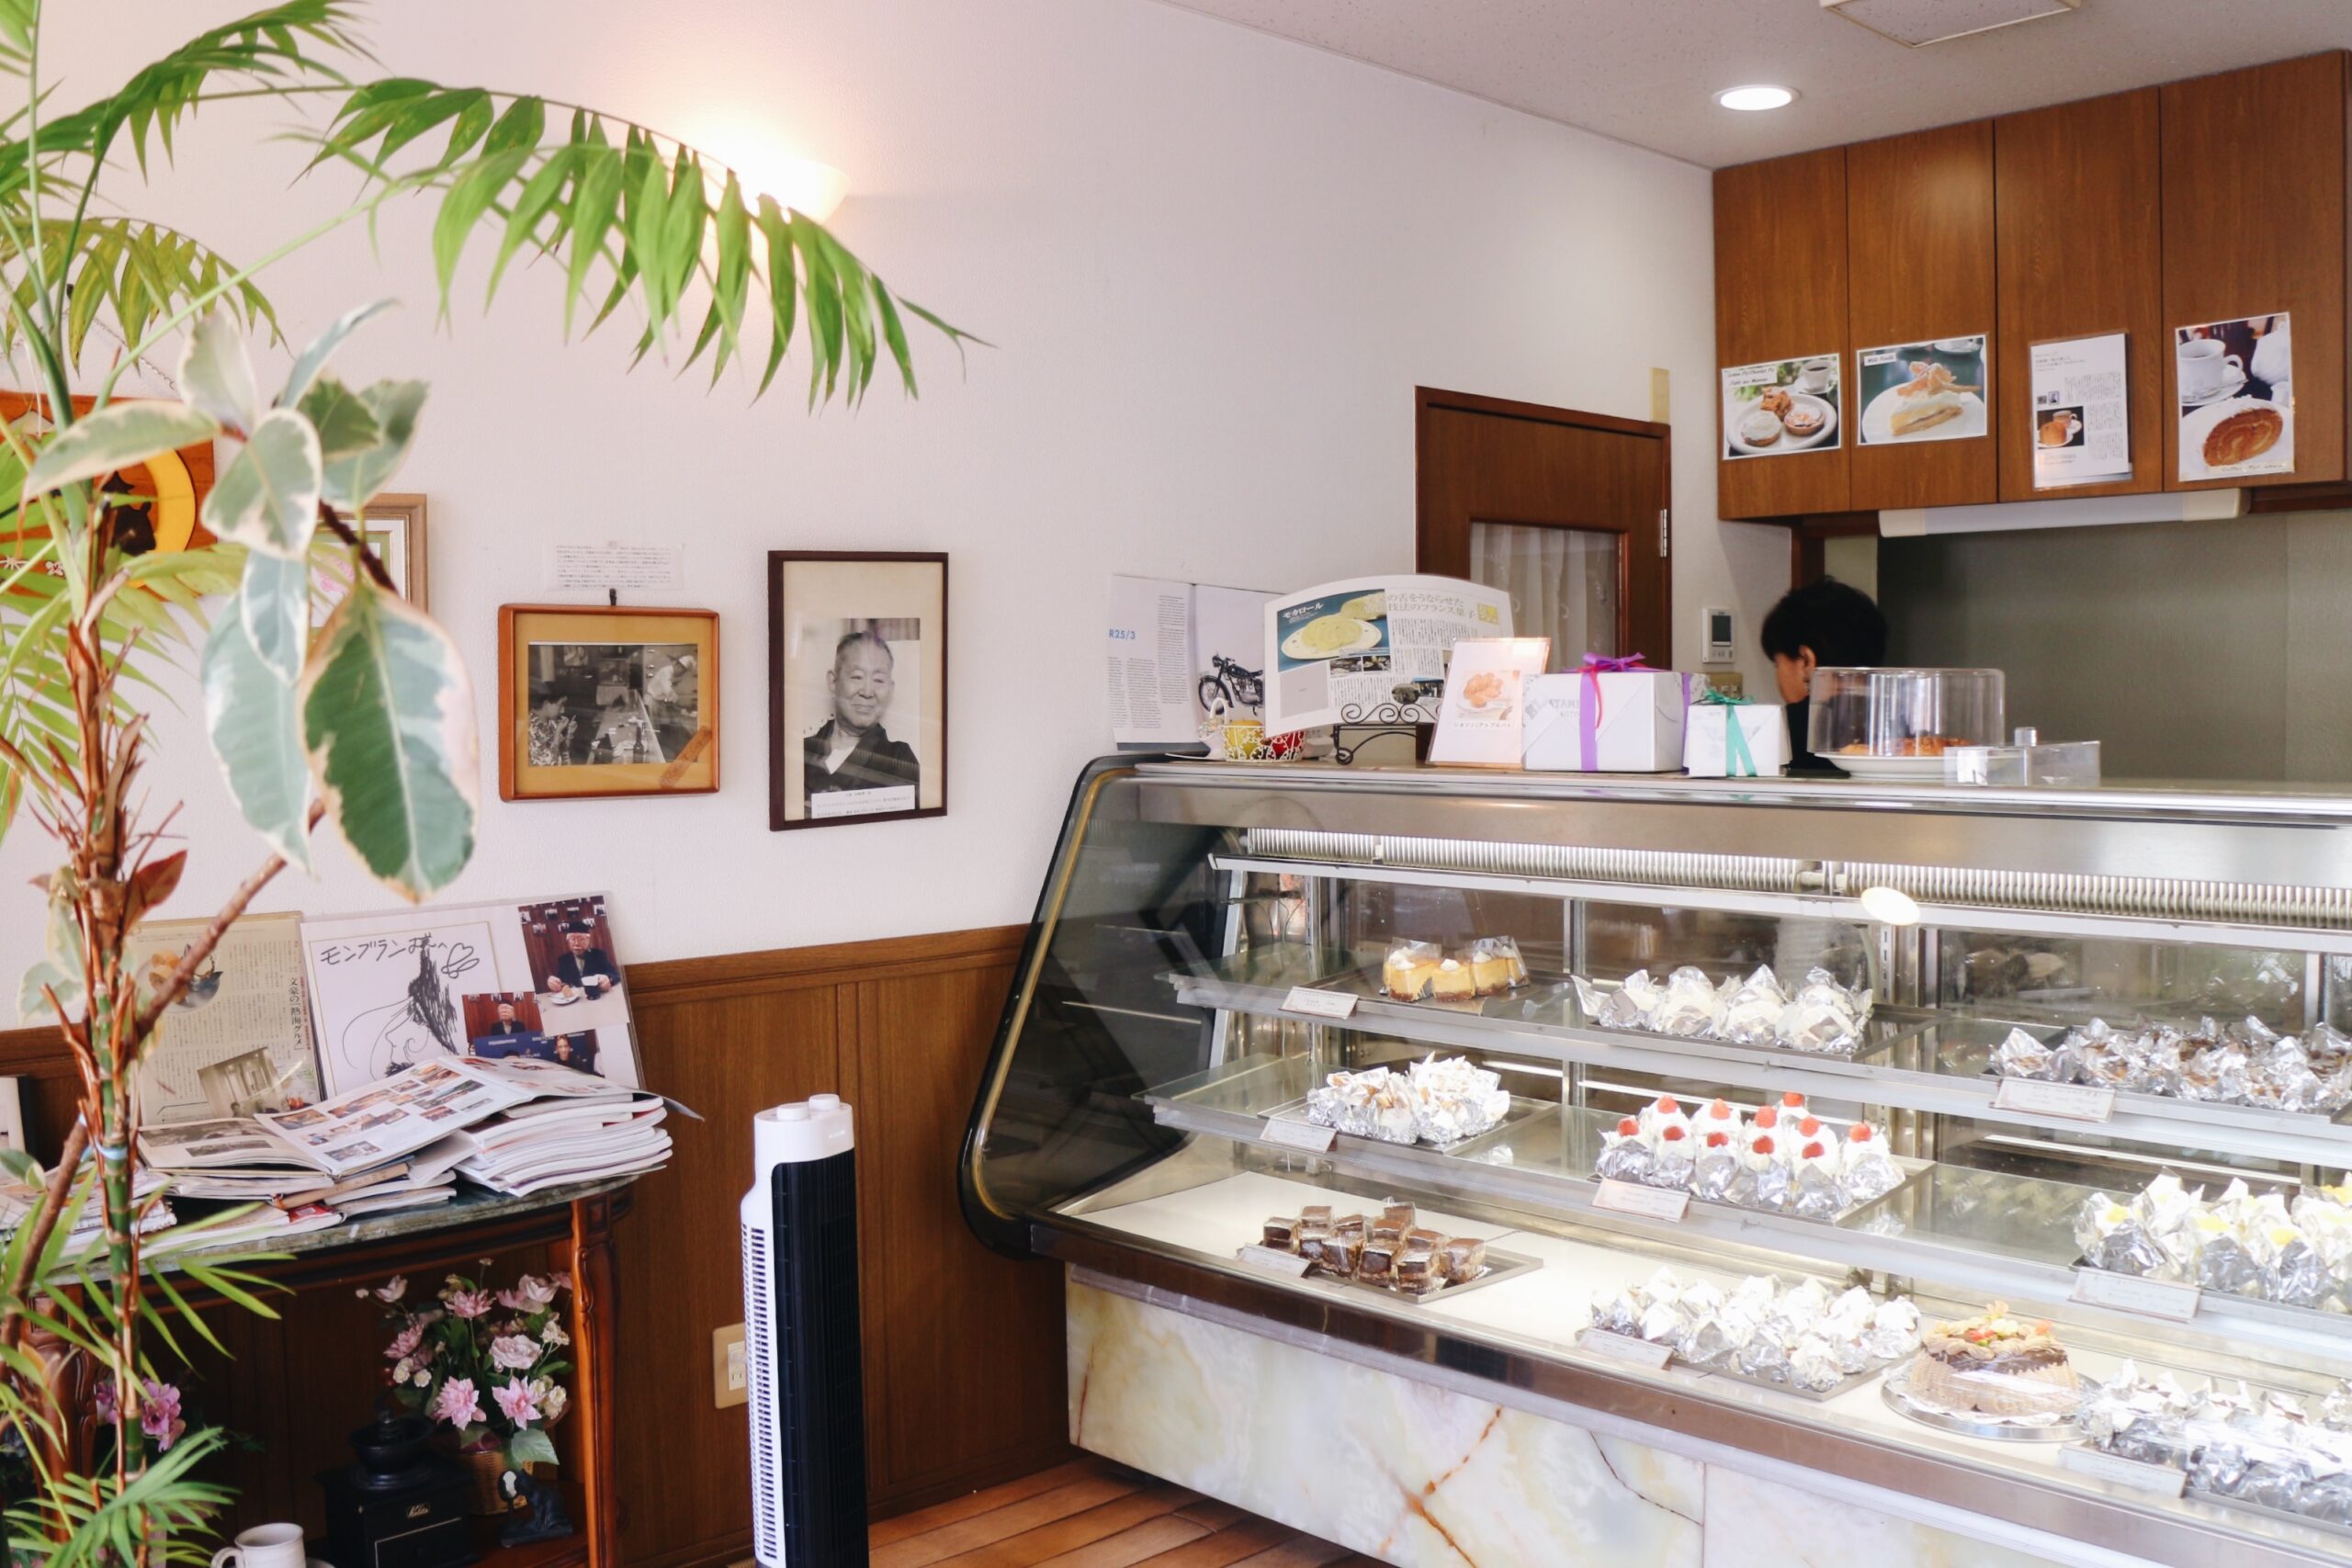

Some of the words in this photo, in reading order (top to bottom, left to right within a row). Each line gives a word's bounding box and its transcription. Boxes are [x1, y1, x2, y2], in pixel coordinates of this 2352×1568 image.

[1283, 603, 1324, 618] モカロール
[1109, 628, 1136, 640] R25/3
